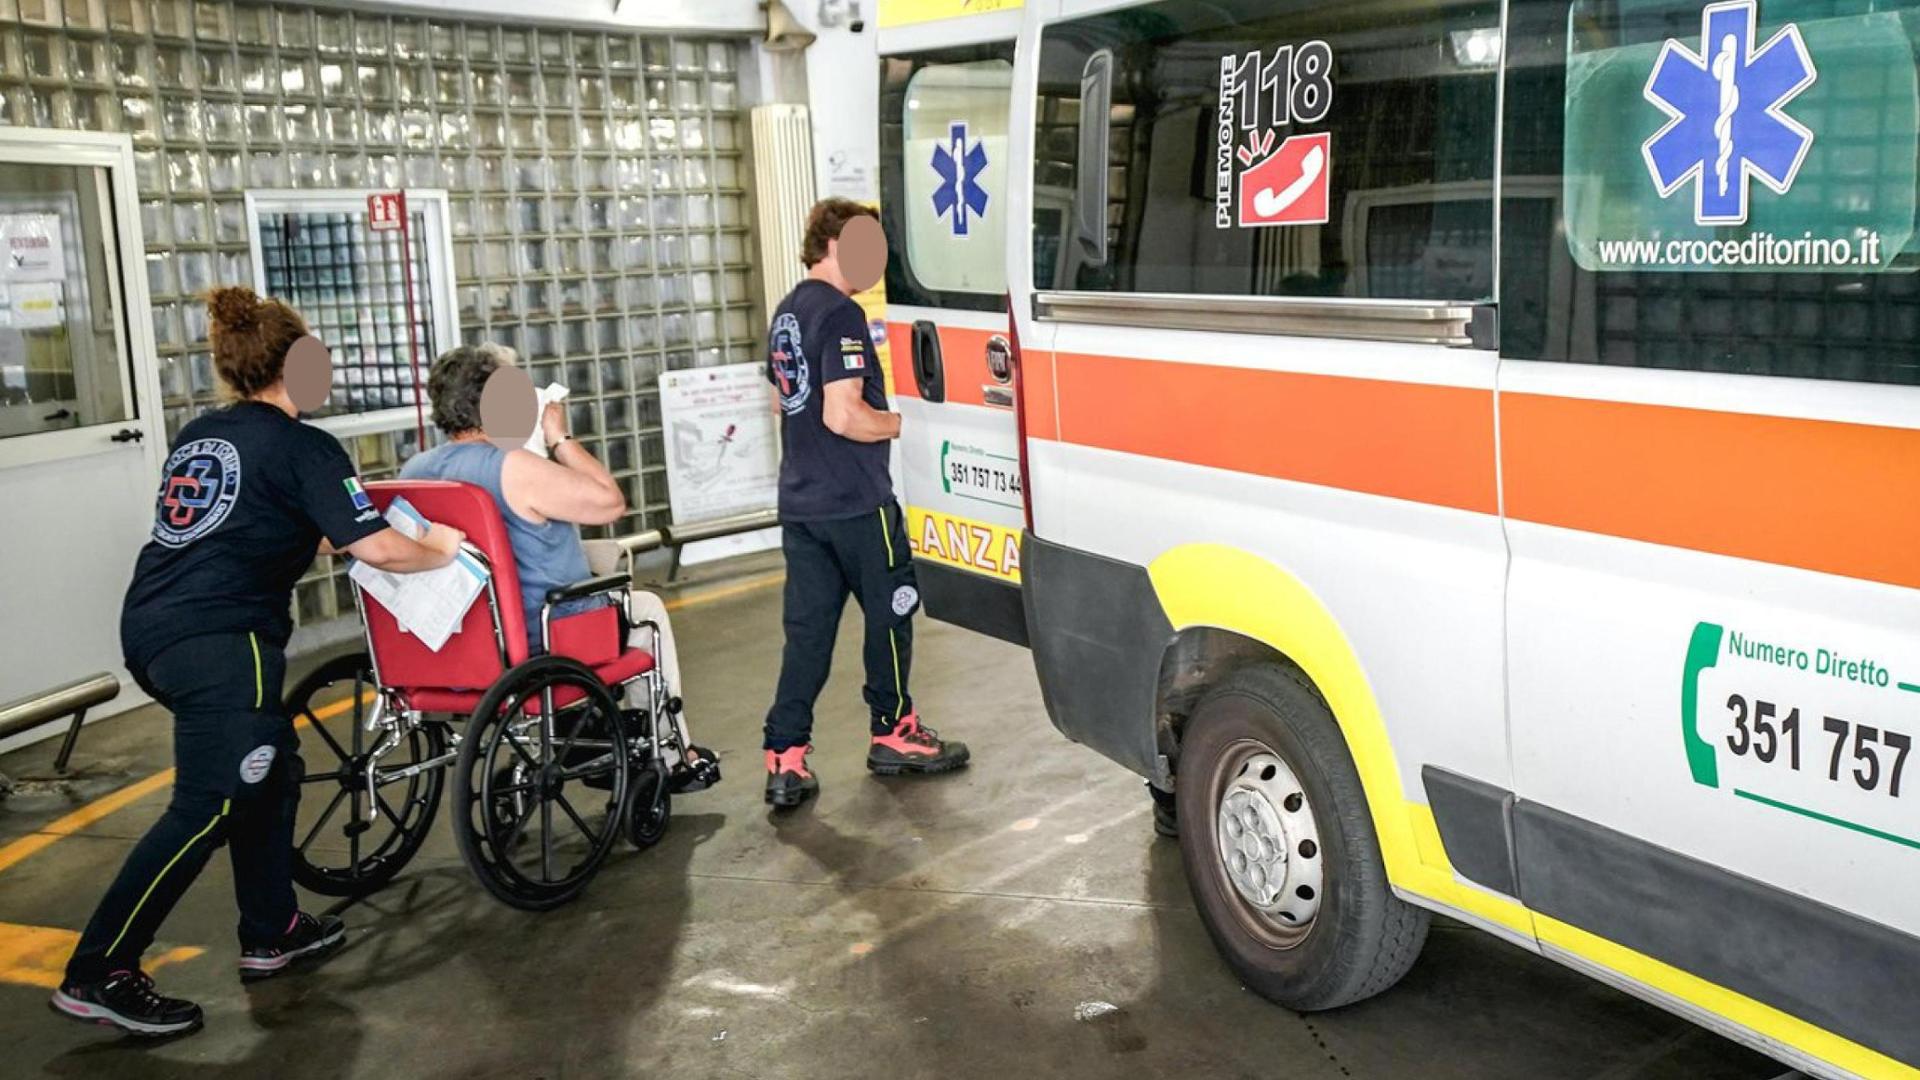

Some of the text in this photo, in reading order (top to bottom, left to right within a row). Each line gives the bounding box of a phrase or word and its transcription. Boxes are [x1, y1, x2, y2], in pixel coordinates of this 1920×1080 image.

[1232, 40, 1333, 130] 118
[1216, 54, 1237, 228] PIEMONTE
[1599, 231, 1880, 265] www.croceditorino.it
[951, 462, 969, 485] 351
[972, 466, 991, 489] 757
[993, 469, 1006, 493] 73
[909, 514, 1021, 576] ANZA
[1727, 631, 1889, 687] Numero Diretto
[1726, 693, 1912, 798] 351 757
